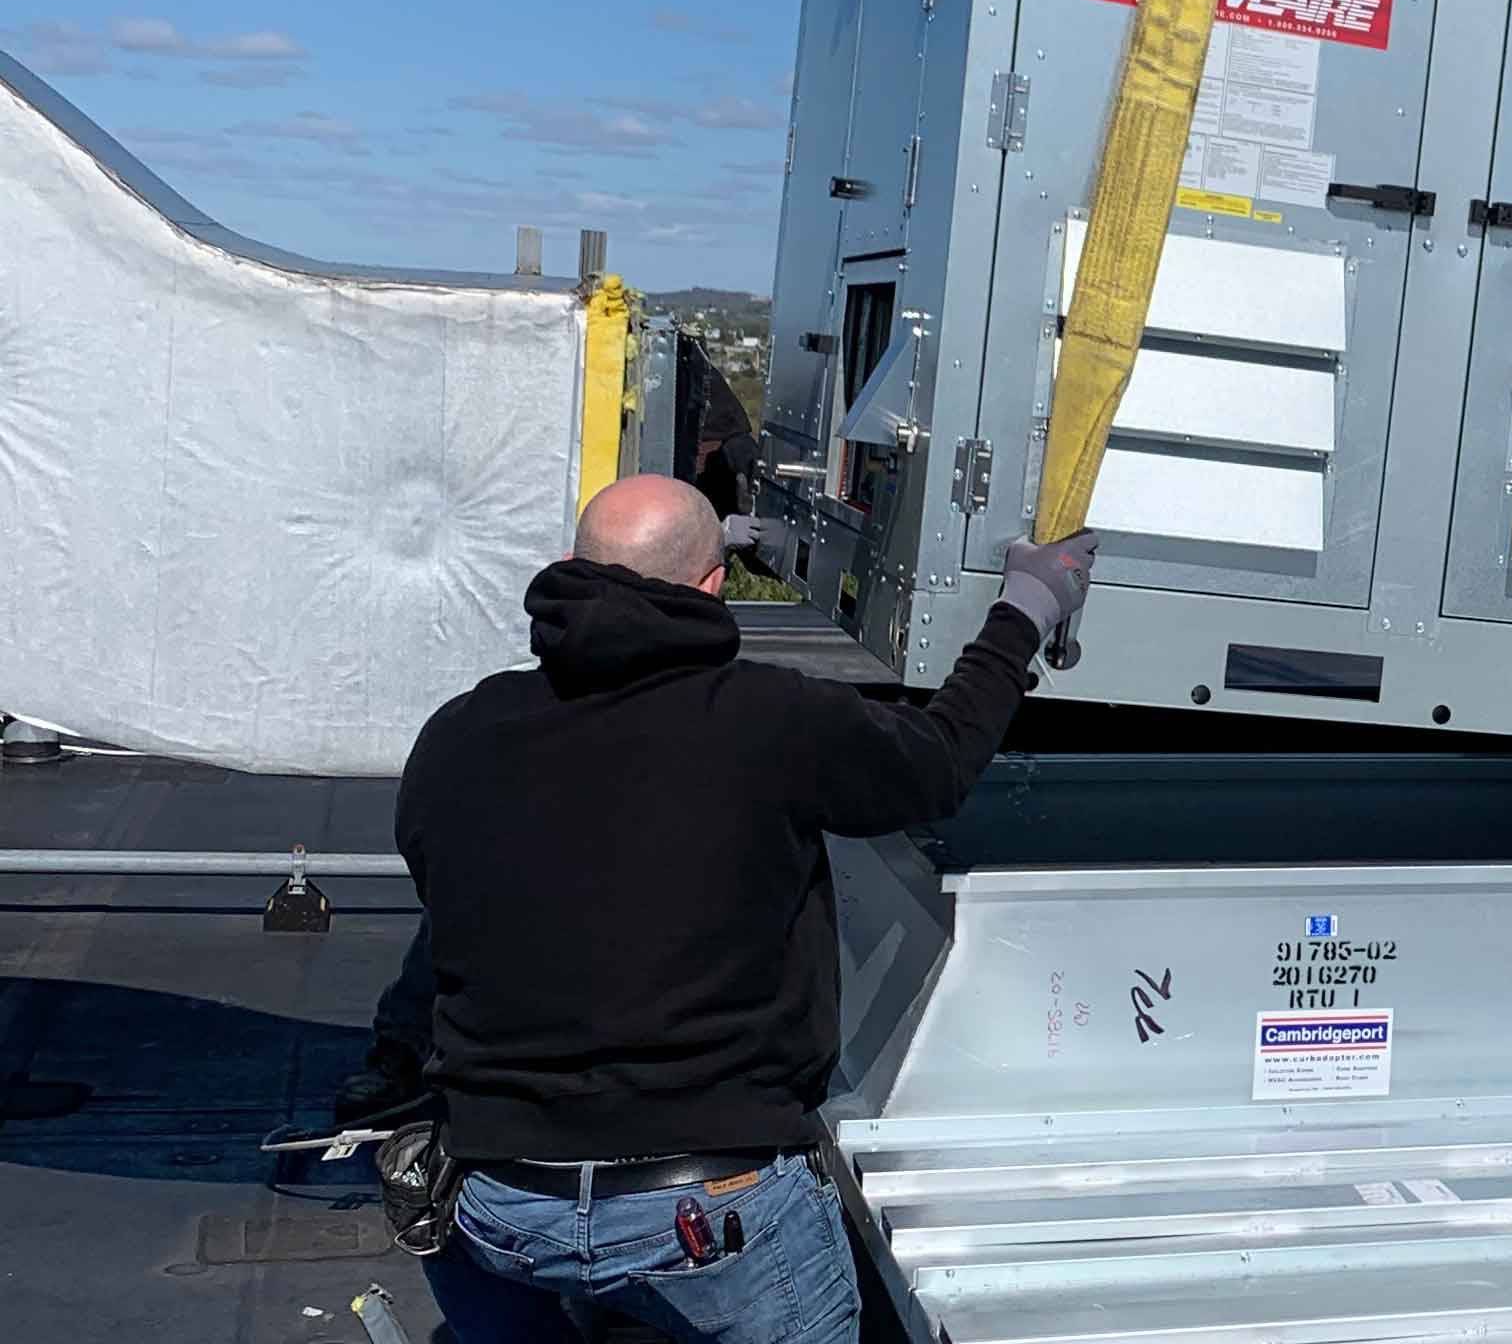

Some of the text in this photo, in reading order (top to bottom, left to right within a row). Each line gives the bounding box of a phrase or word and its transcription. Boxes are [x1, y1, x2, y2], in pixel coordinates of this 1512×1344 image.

[1276, 940, 1398, 961] 91785-02
[1272, 965, 1377, 986] 2016270
[1289, 988, 1336, 1009] RTU
[1265, 1025, 1385, 1044] Cambridgeport
